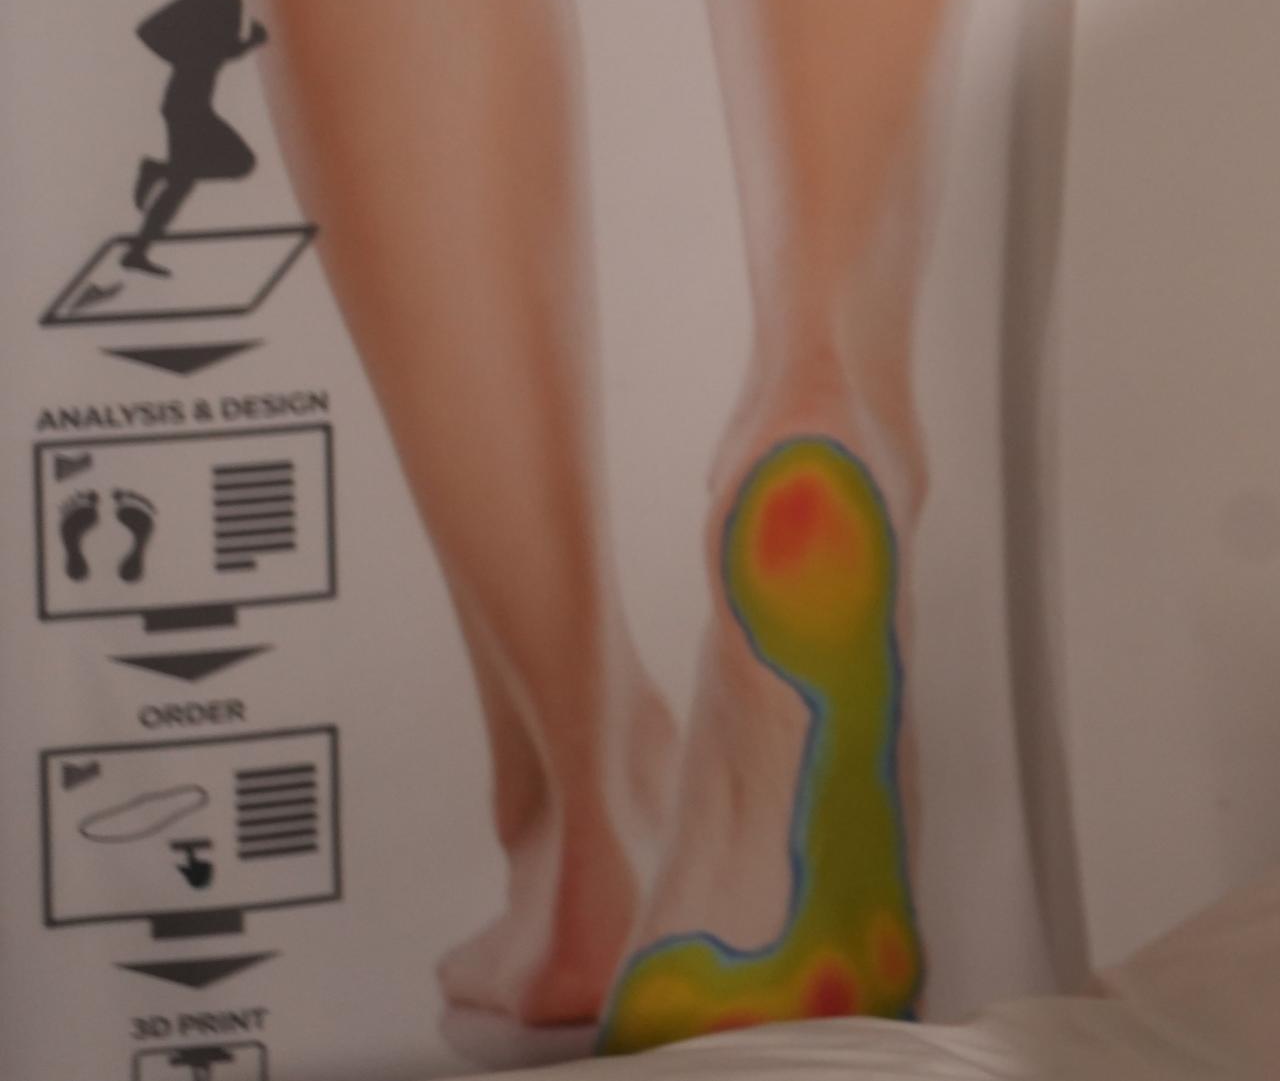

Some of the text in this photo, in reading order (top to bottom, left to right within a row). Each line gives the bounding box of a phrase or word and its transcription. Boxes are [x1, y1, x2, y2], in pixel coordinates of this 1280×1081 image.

[37, 390, 329, 431] ANALYSIS & DESIGN
[136, 697, 247, 731] ORDER
[129, 1006, 269, 1041] 3D PRINT
